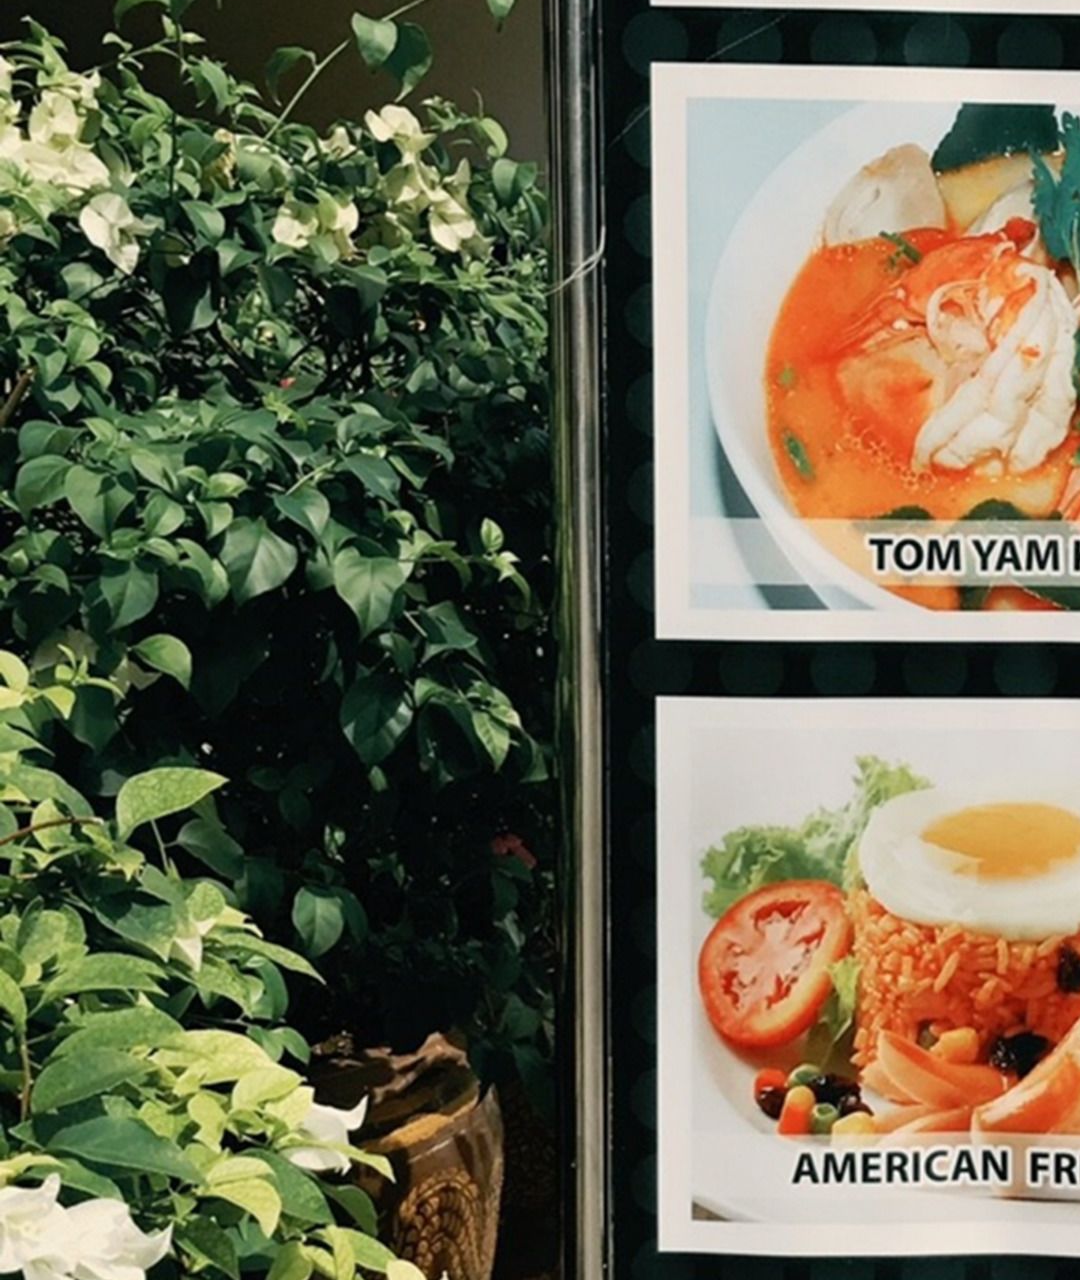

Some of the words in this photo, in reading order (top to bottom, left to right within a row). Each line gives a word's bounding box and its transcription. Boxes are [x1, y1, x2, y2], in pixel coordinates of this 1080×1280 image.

[868, 538, 962, 572] TOM
[971, 539, 1060, 572] YAM
[791, 1149, 1009, 1184] AMERICAN
